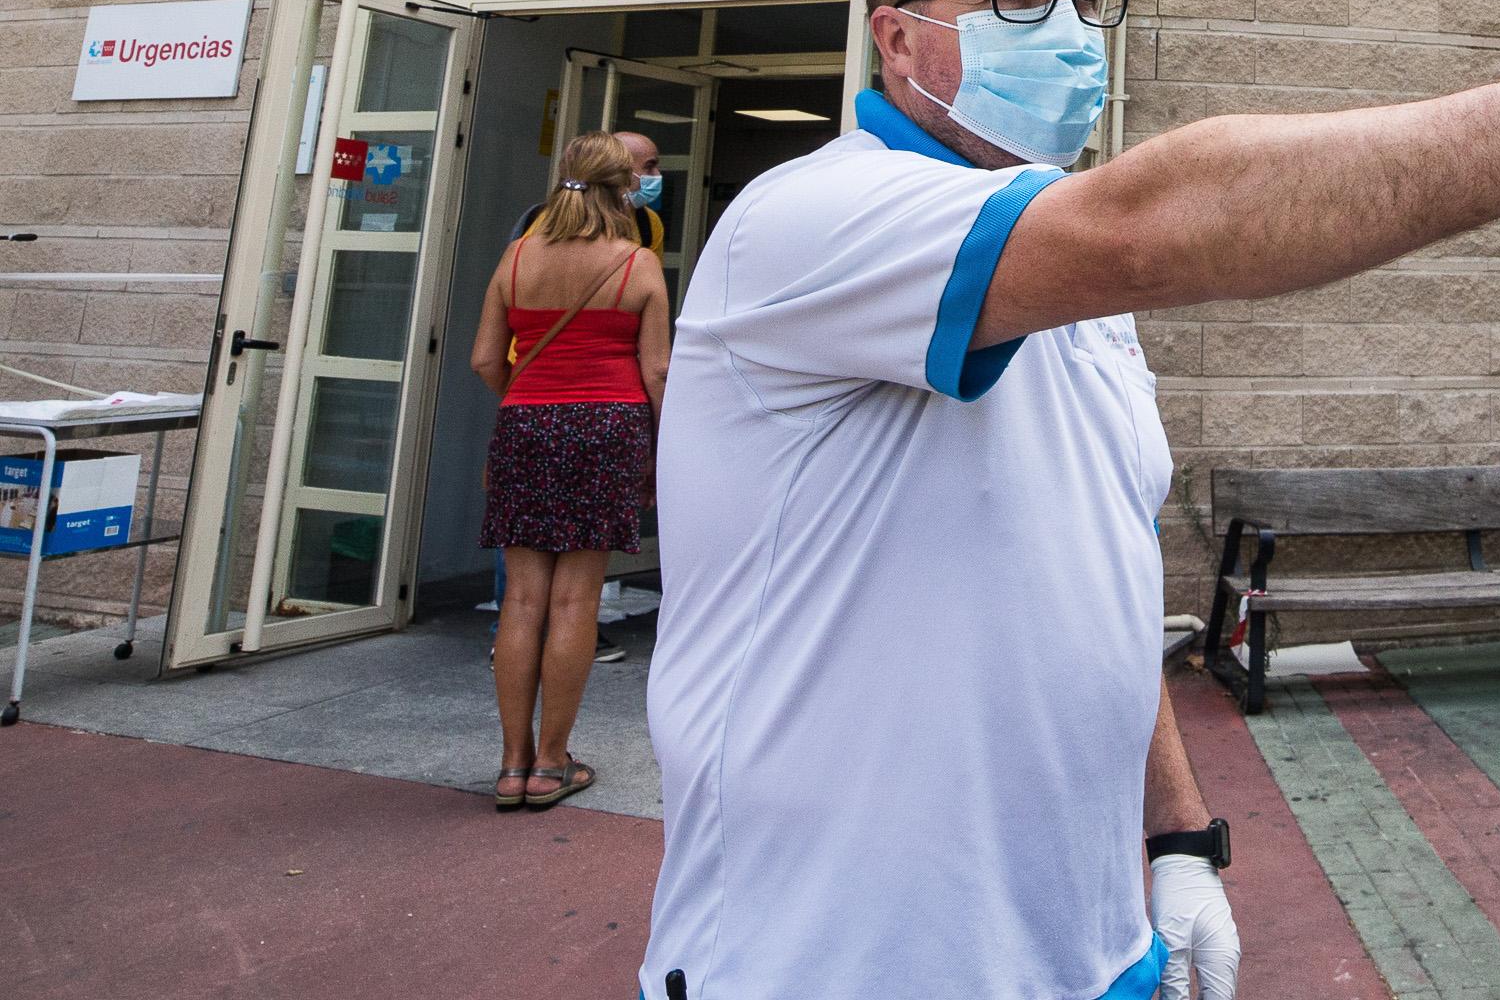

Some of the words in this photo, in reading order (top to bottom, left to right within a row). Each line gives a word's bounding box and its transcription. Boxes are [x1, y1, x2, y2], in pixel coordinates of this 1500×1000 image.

[119, 35, 233, 67] Urgencias
[4, 465, 28, 479] target
[66, 519, 91, 528] target
